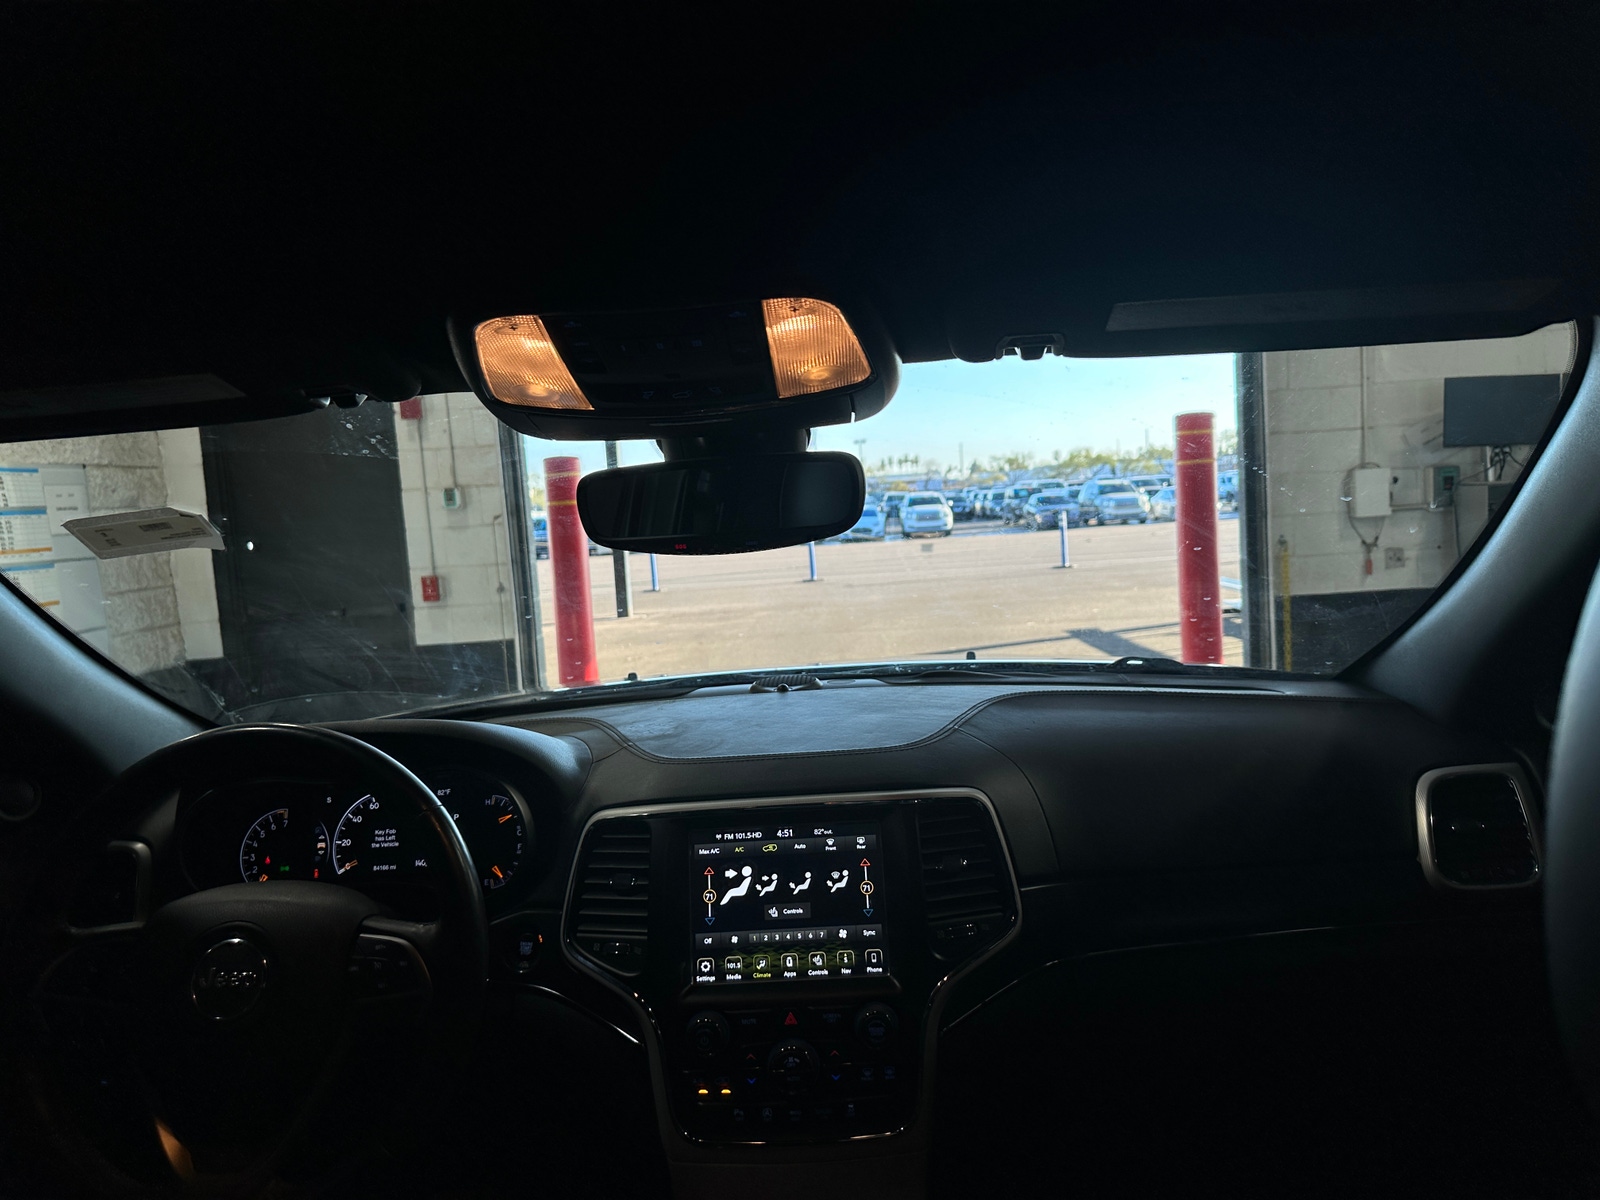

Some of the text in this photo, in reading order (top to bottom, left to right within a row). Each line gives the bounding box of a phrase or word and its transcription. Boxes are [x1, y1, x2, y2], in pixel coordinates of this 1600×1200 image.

[326, 796, 332, 804] S
[369, 802, 380, 810] 60
[352, 815, 362, 823] 40
[271, 823, 277, 831] 6
[283, 820, 288, 828] 7
[260, 830, 265, 838] 5
[776, 829, 793, 837] 4:51
[341, 838, 351, 846] 20
[250, 853, 256, 861] 3
[252, 866, 258, 874] 2
[862, 884, 871, 892] 71
[705, 892, 714, 900] 71
[862, 929, 876, 937] Sync
[703, 937, 713, 945] Off
[783, 970, 797, 978] Apps
[696, 975, 716, 983] Settings
